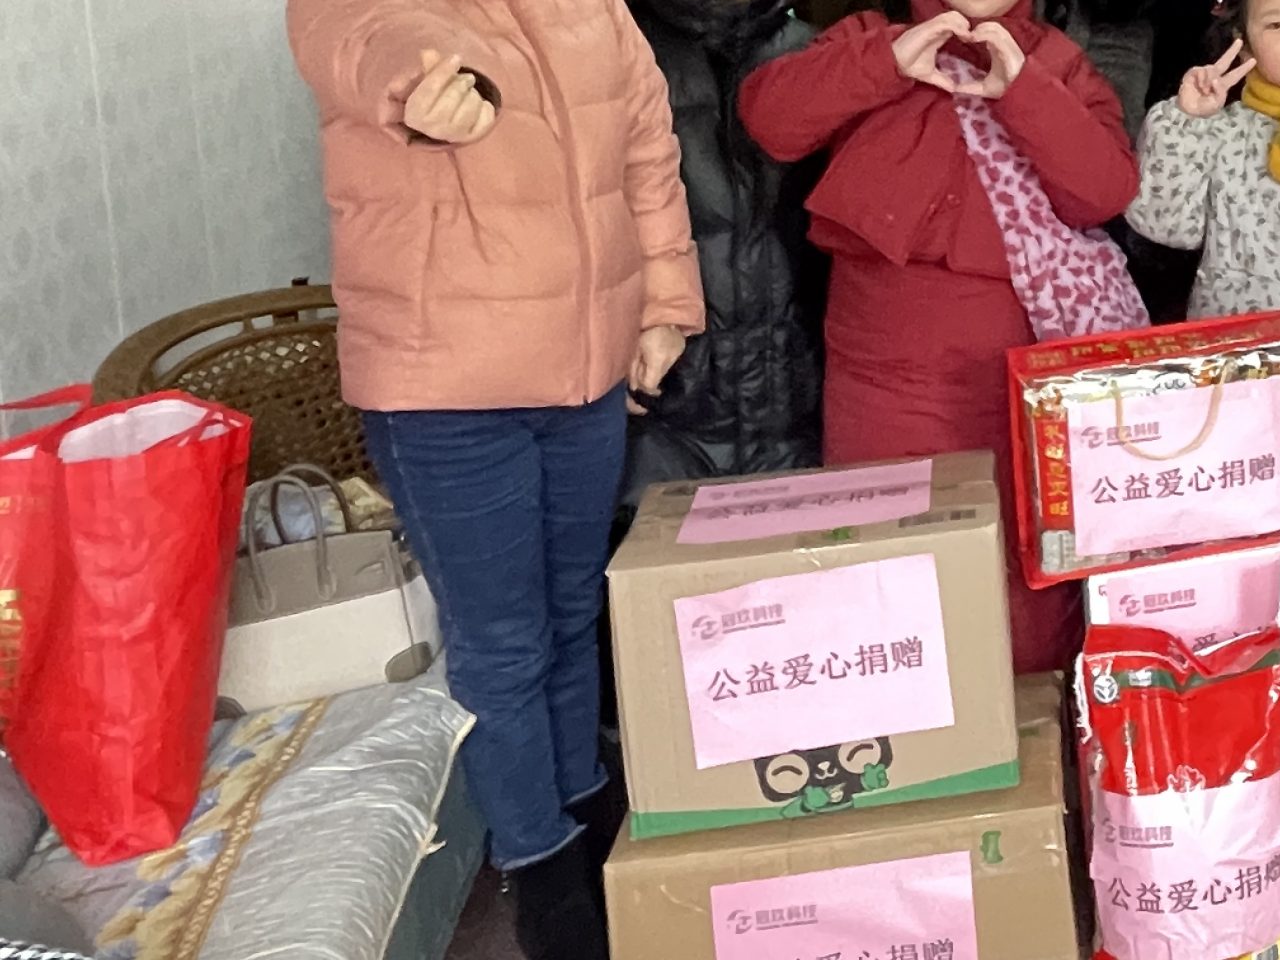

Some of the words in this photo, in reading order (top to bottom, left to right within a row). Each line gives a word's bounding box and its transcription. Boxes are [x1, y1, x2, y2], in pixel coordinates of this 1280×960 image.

[1091, 453, 1276, 504] 公益爱心捐赠
[707, 636, 925, 702] 公益爱心捐赠
